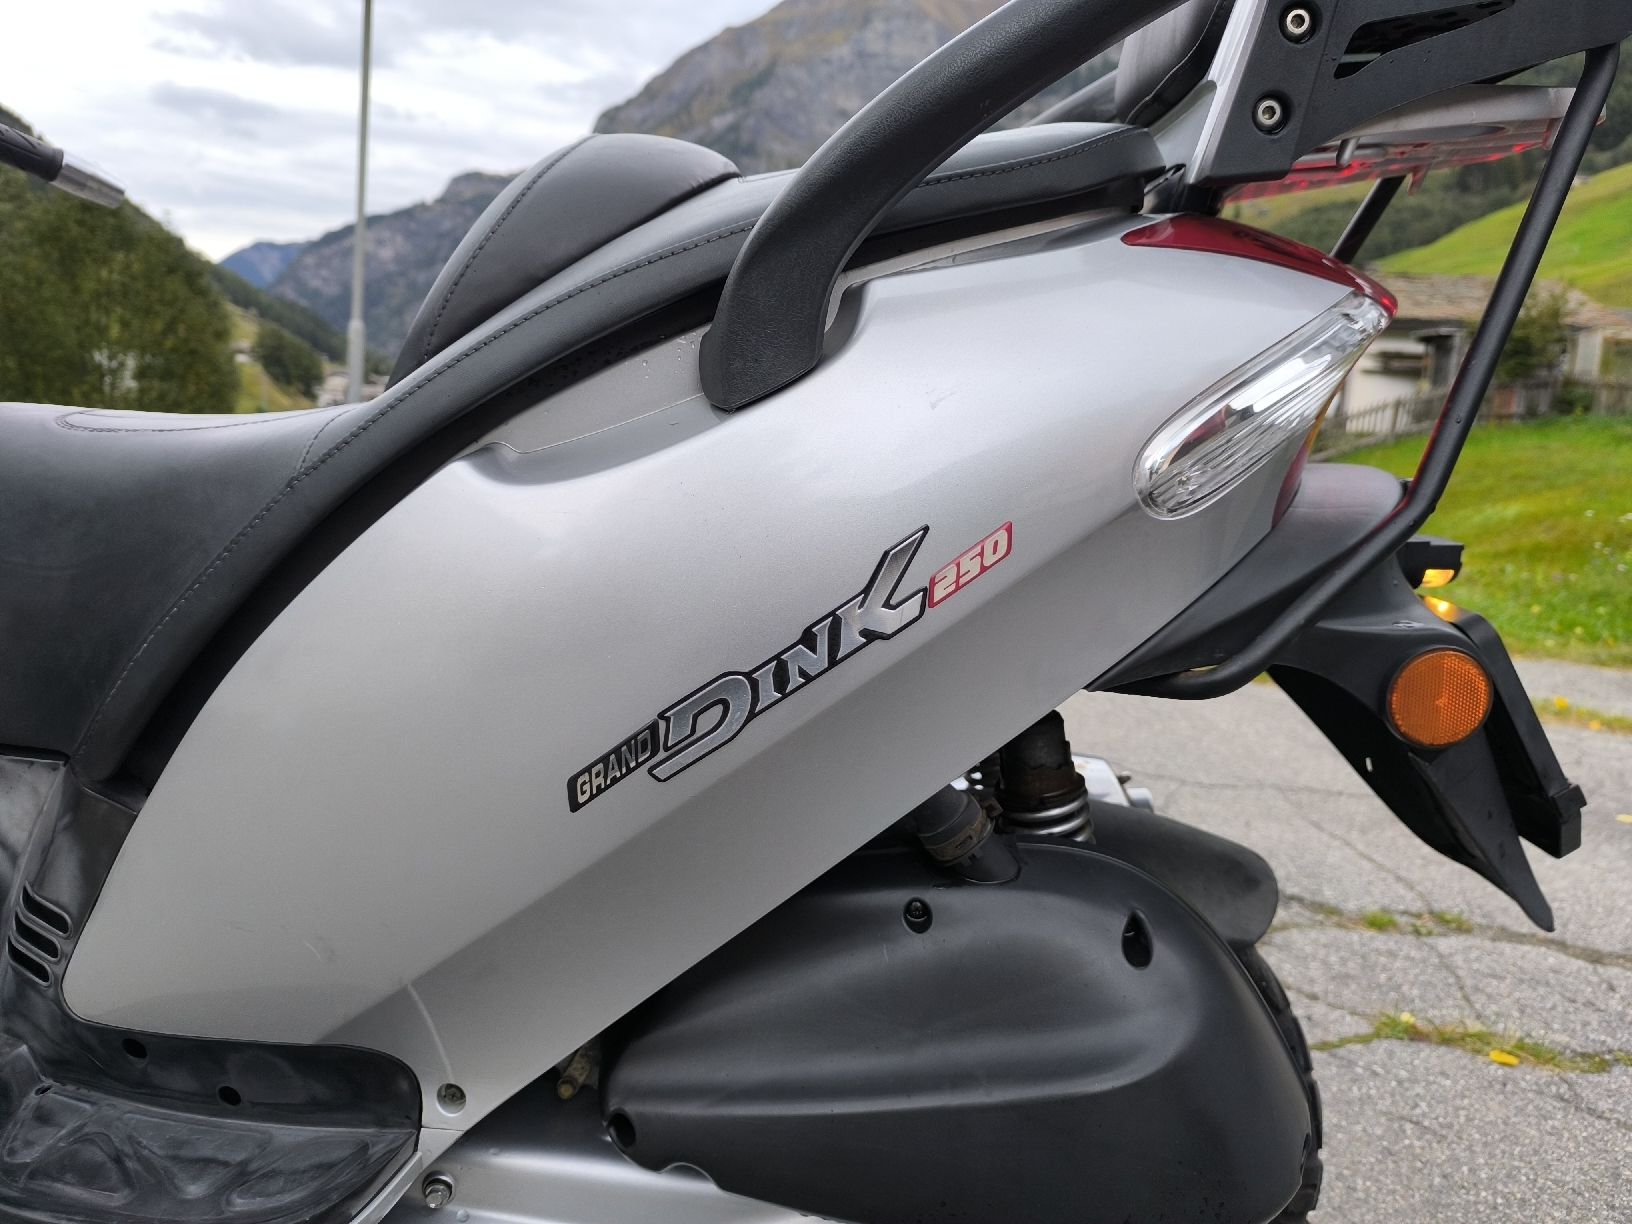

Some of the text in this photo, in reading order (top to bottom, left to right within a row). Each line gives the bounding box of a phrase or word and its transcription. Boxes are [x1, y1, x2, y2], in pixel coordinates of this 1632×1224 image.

[575, 525, 1008, 804] GRAND DINK 250
